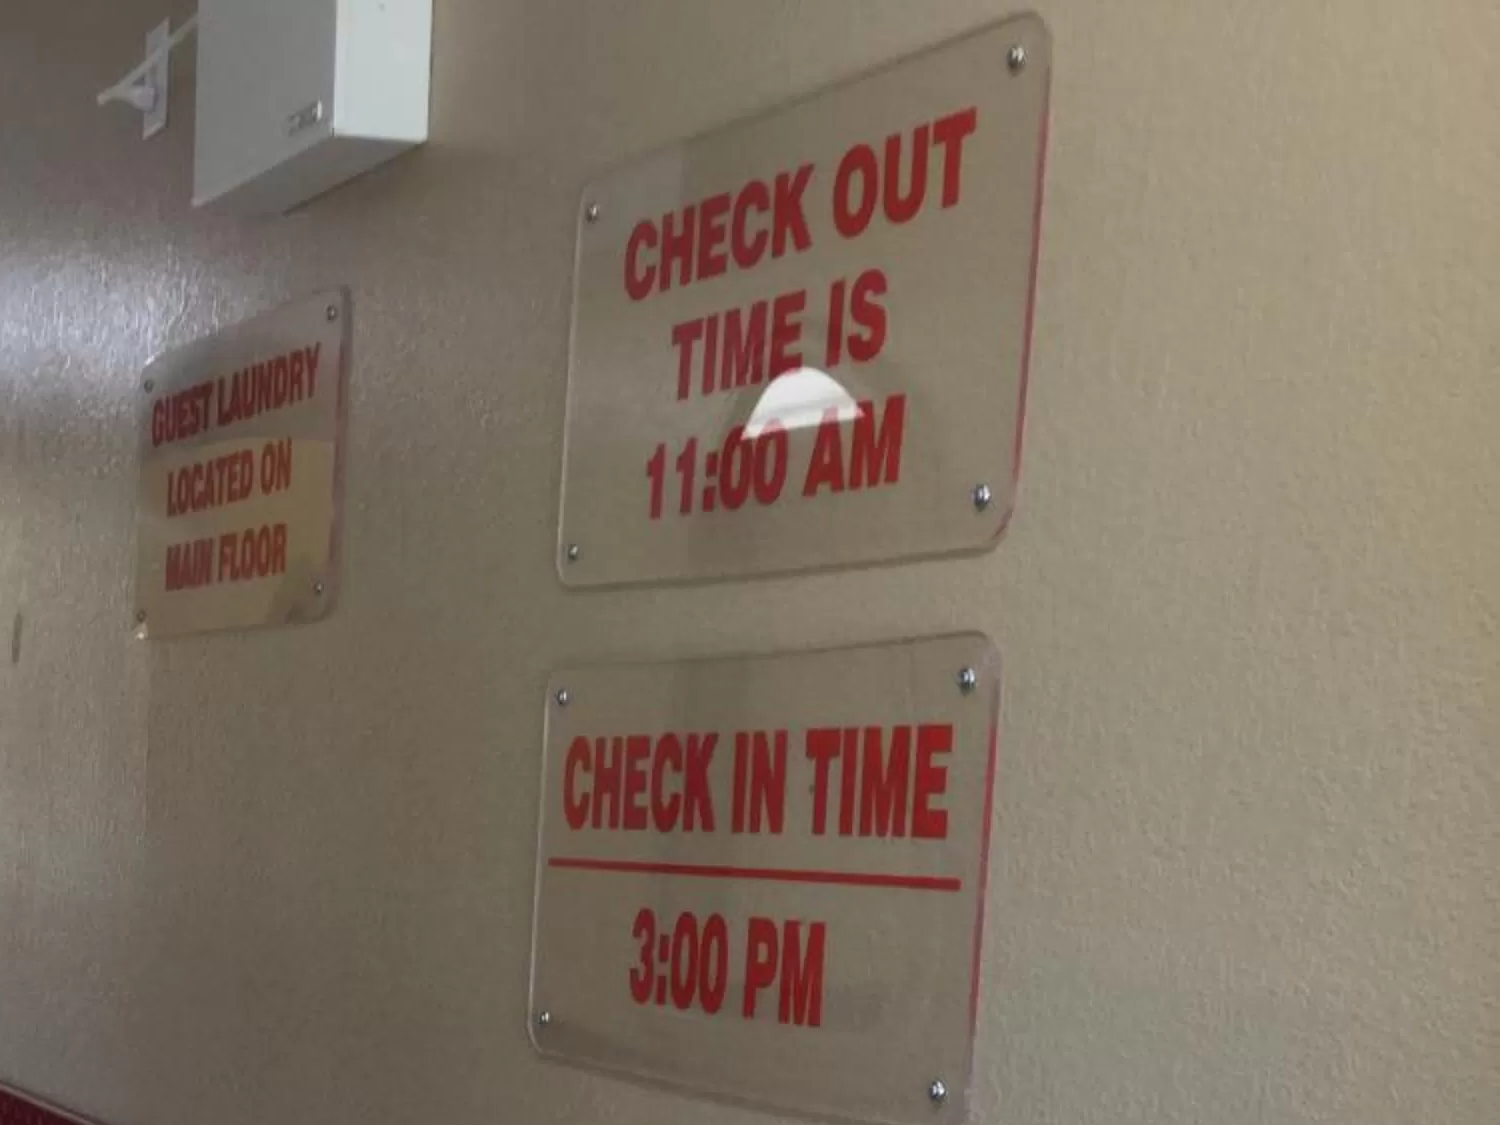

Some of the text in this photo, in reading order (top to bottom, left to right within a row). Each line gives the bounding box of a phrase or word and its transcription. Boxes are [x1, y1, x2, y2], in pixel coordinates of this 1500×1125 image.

[624, 106, 977, 300] CHECK OUT
[671, 268, 888, 402] TIME IS
[152, 342, 321, 448] GUEST LAUNDRY
[167, 437, 292, 518] LOCATED ON
[645, 394, 906, 519] 11:00 AM
[165, 523, 287, 592] MAIN FLOOR
[563, 724, 953, 839] CHECK IN TIME
[629, 908, 826, 1027] 3:00 PM
